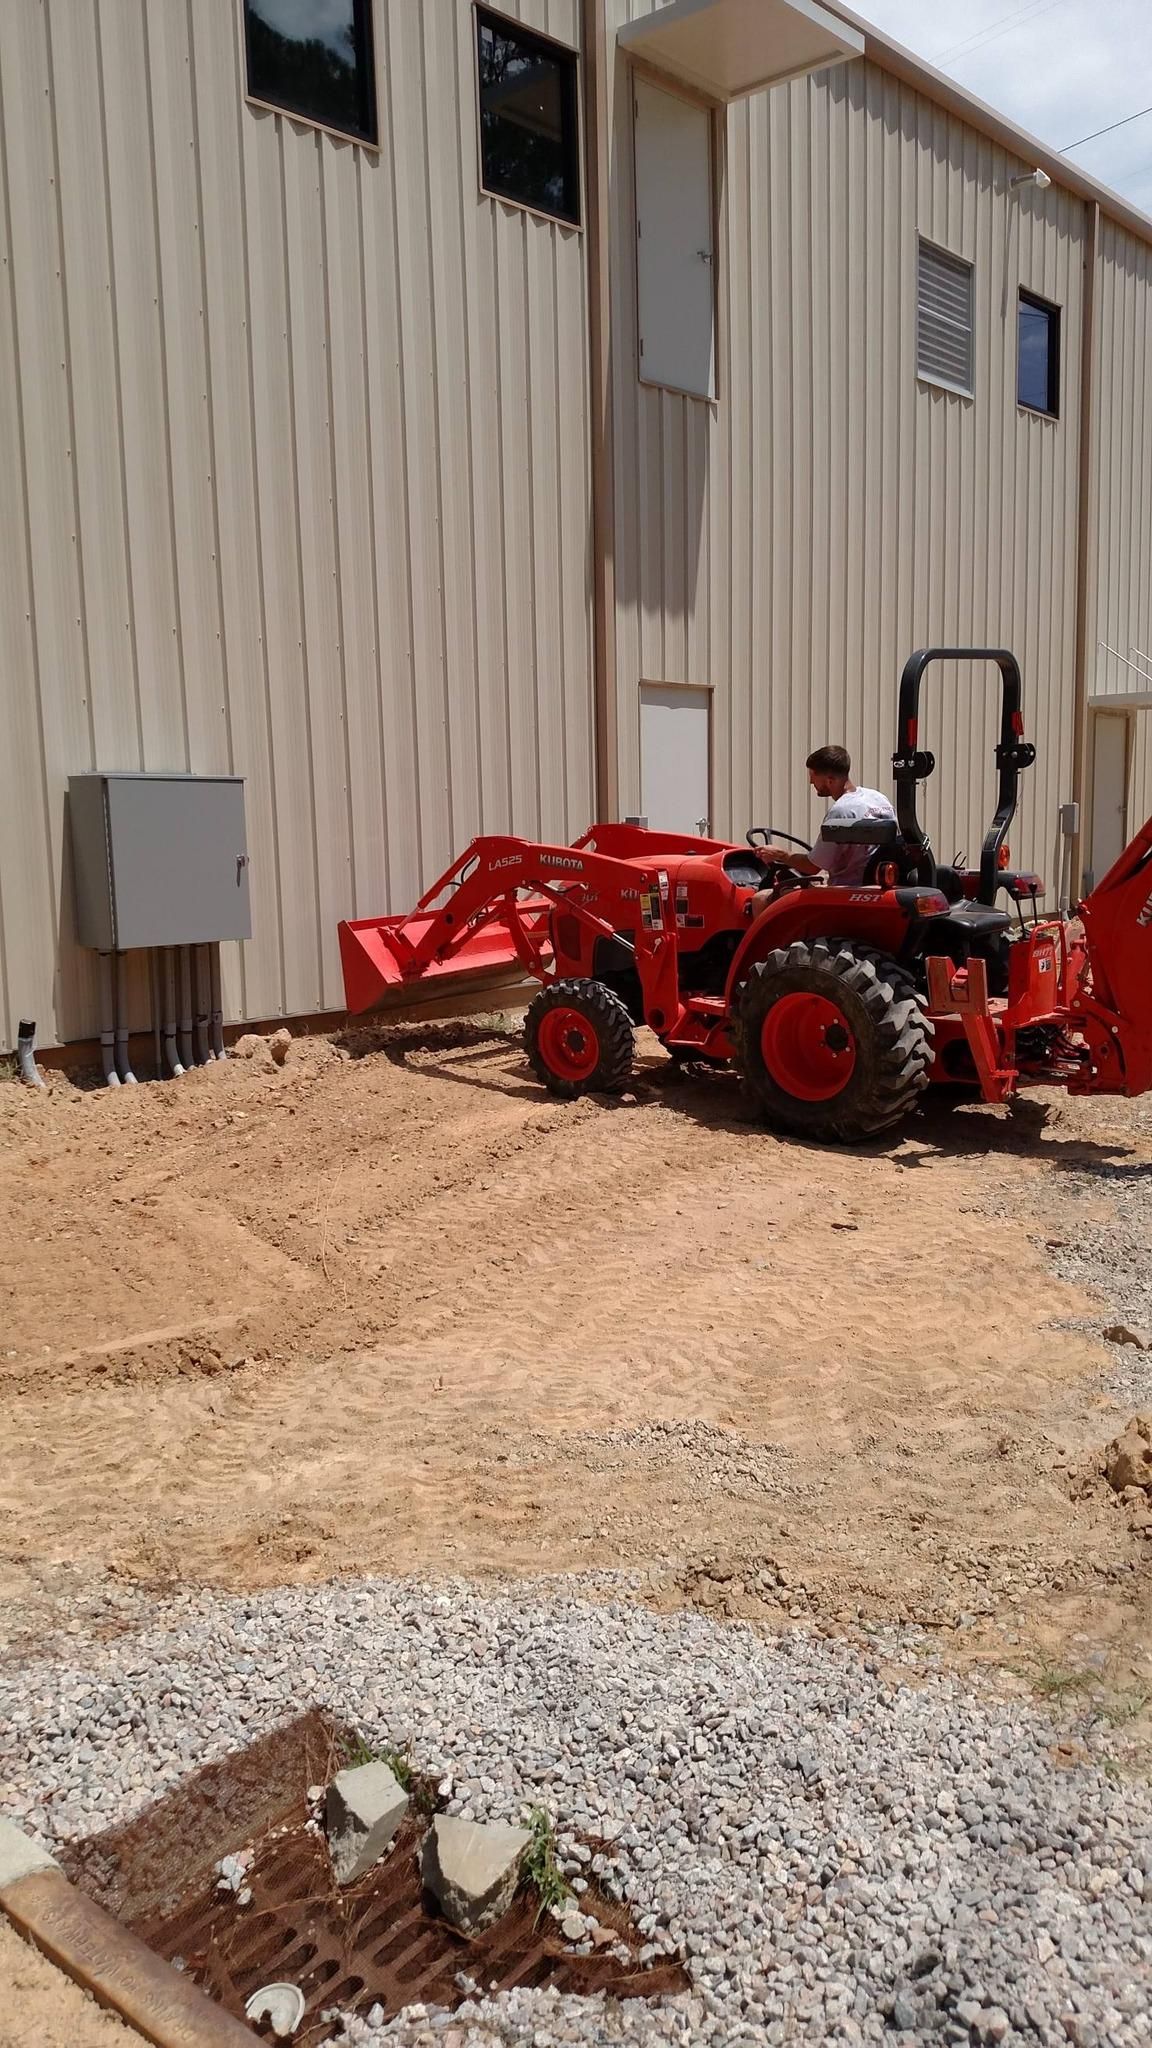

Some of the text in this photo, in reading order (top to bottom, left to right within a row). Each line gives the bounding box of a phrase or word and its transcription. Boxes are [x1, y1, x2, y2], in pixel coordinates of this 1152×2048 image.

[488, 854, 523, 872] LA525
[539, 854, 584, 871] KUBOTA
[849, 893, 884, 902] HST
[42, 1910, 120, 1978] WATERWAYS
[144, 1992, 197, 2041] DRAINS
